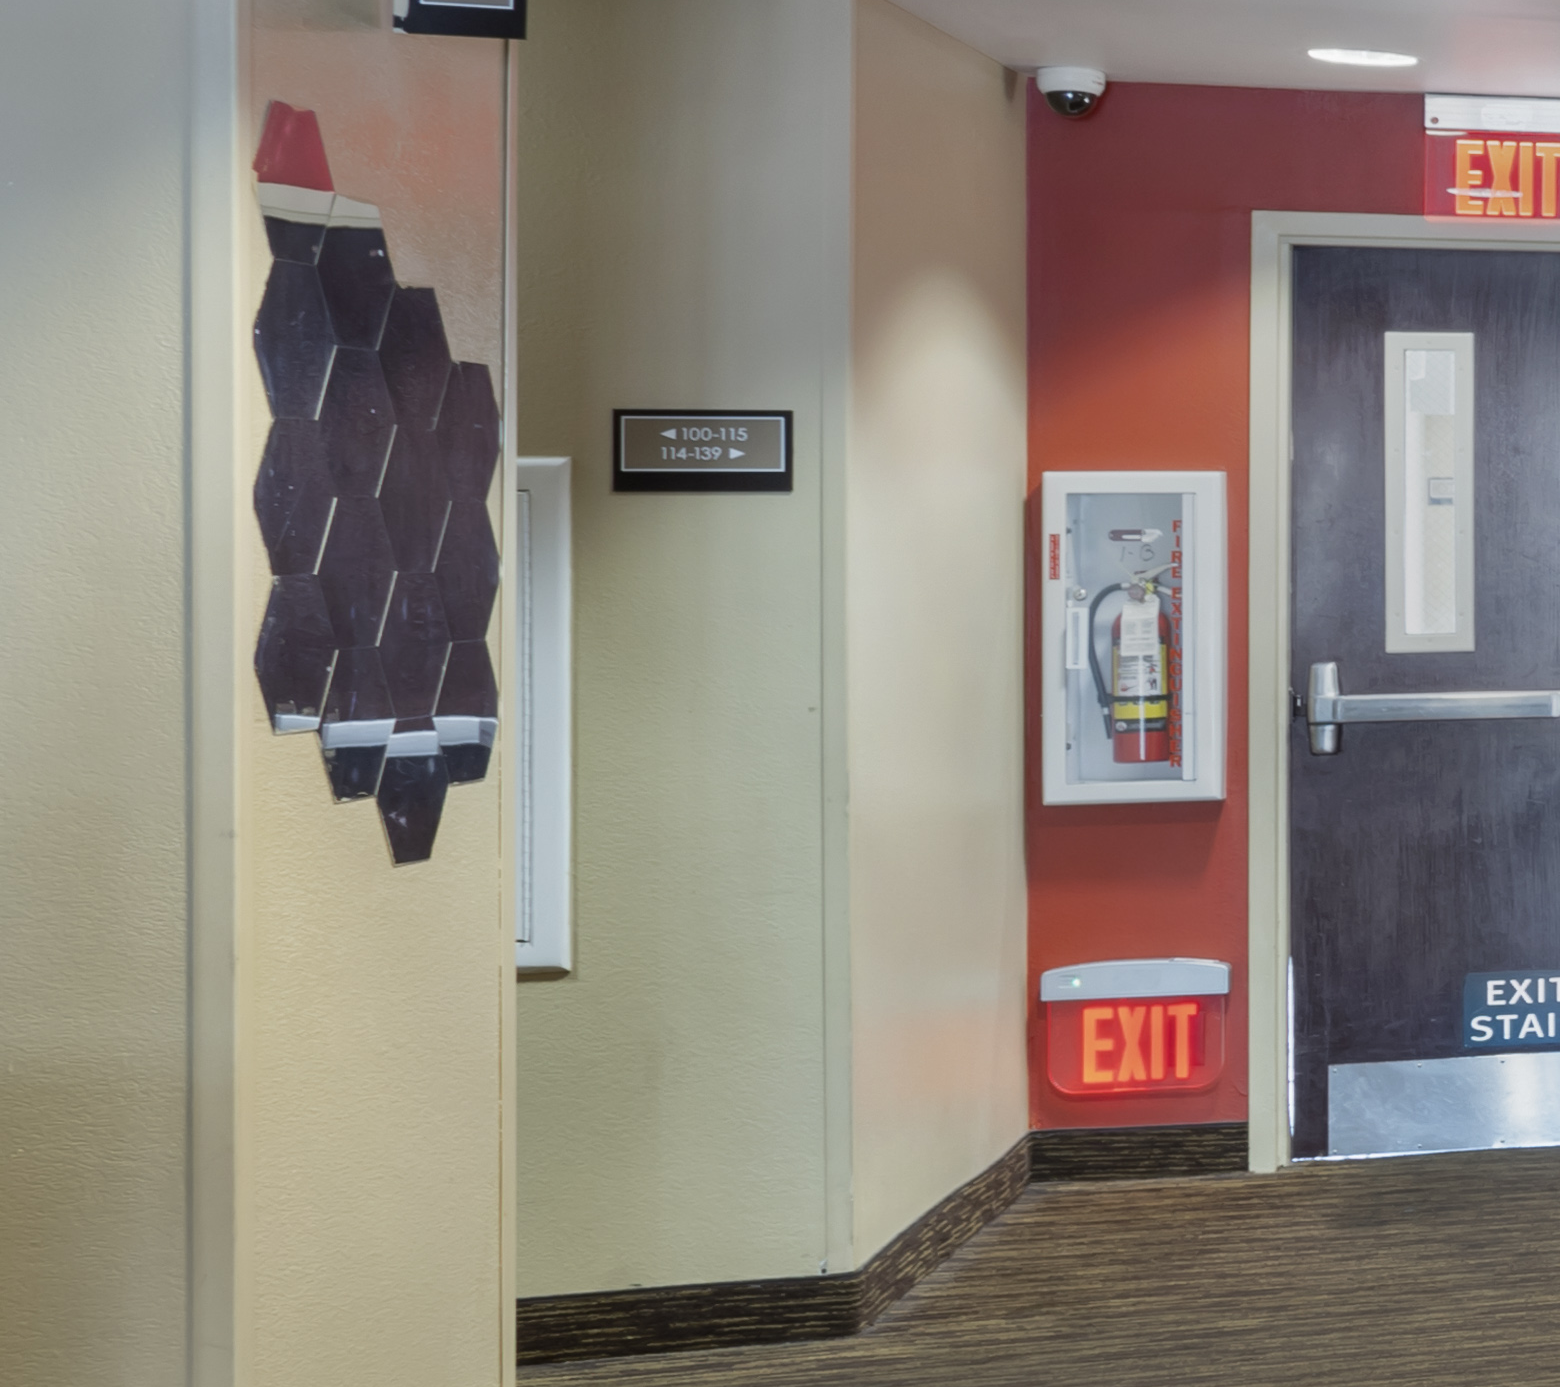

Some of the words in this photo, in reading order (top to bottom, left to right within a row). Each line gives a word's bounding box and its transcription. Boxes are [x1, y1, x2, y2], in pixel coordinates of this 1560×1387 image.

[660, 446, 723, 461] 114-139
[681, 427, 748, 442] 100-115
[1171, 520, 1182, 579] FIRE
[1169, 587, 1182, 768] EXTINGUISHER
[1082, 1002, 1198, 1084] EXIT
